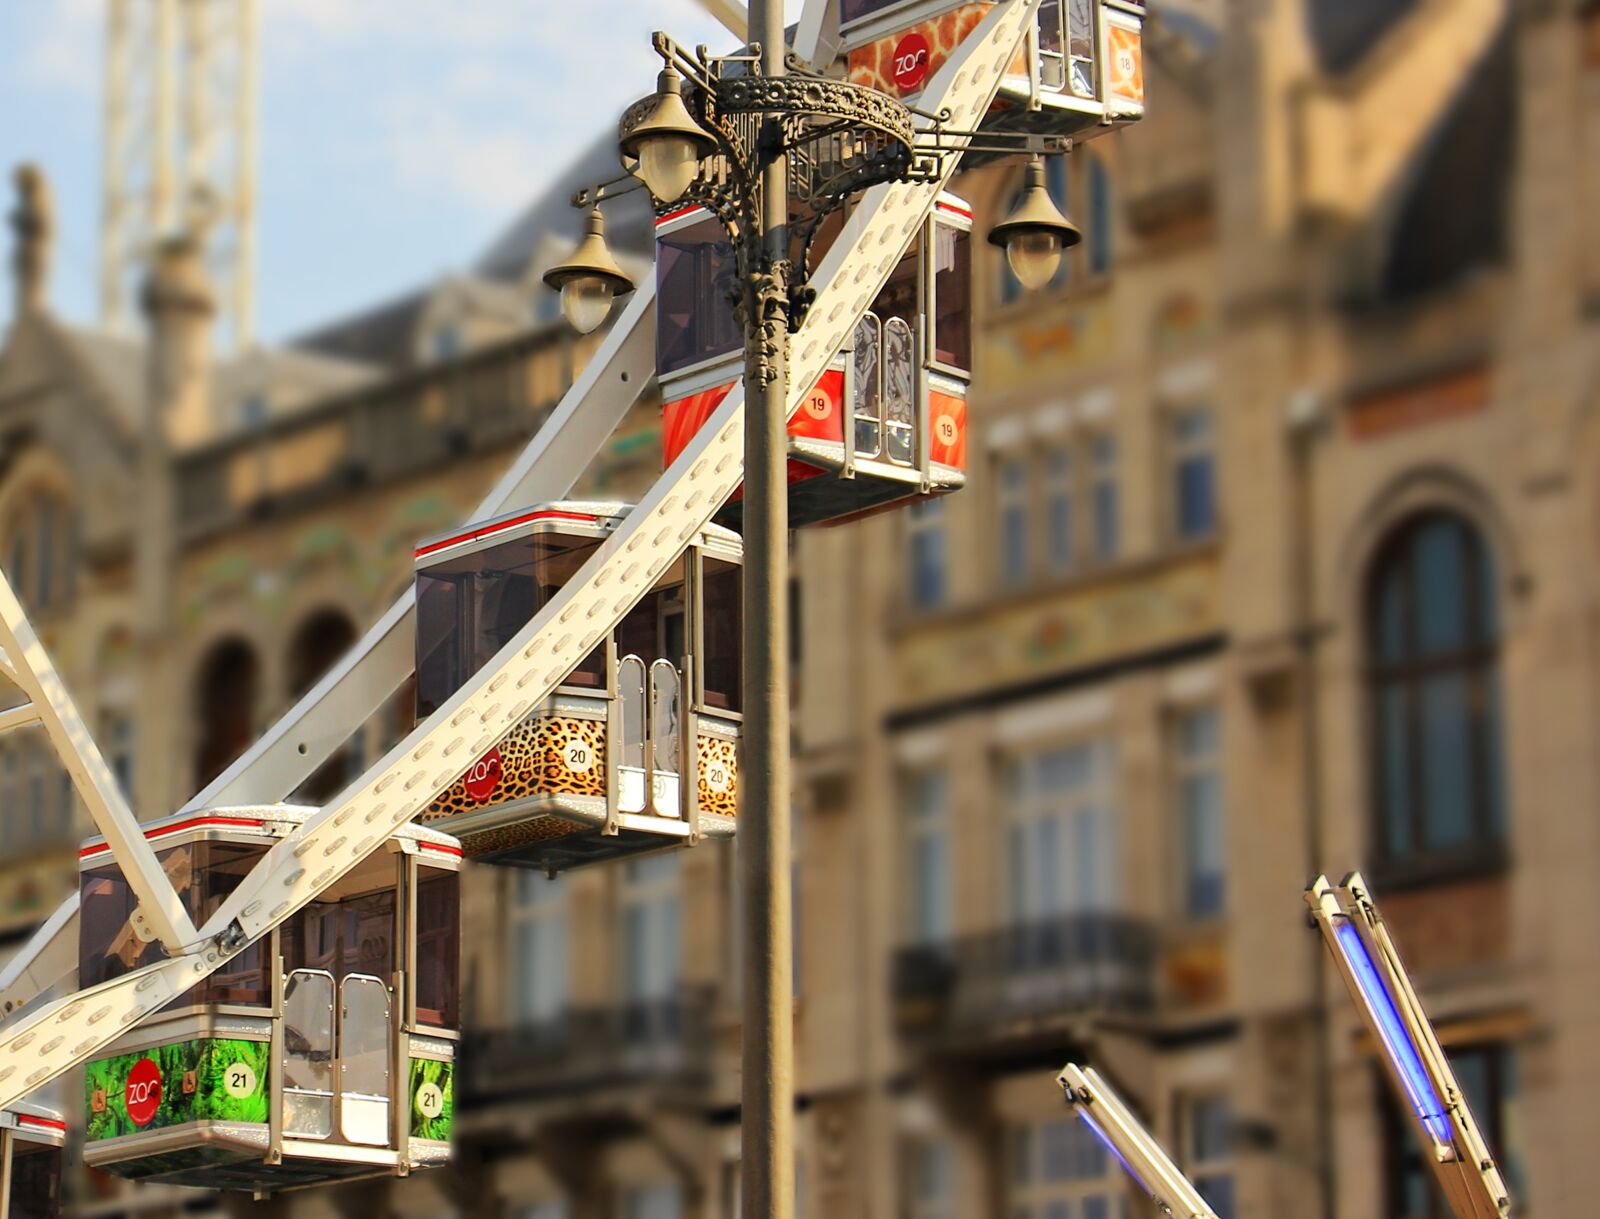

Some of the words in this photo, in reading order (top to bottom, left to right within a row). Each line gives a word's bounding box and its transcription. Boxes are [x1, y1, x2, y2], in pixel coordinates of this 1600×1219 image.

[811, 397, 825, 412] 19
[941, 423, 953, 437] 19
[570, 749, 586, 764] 20
[711, 769, 723, 784] 20
[231, 1073, 247, 1088] 21
[423, 1092, 436, 1108] 21
